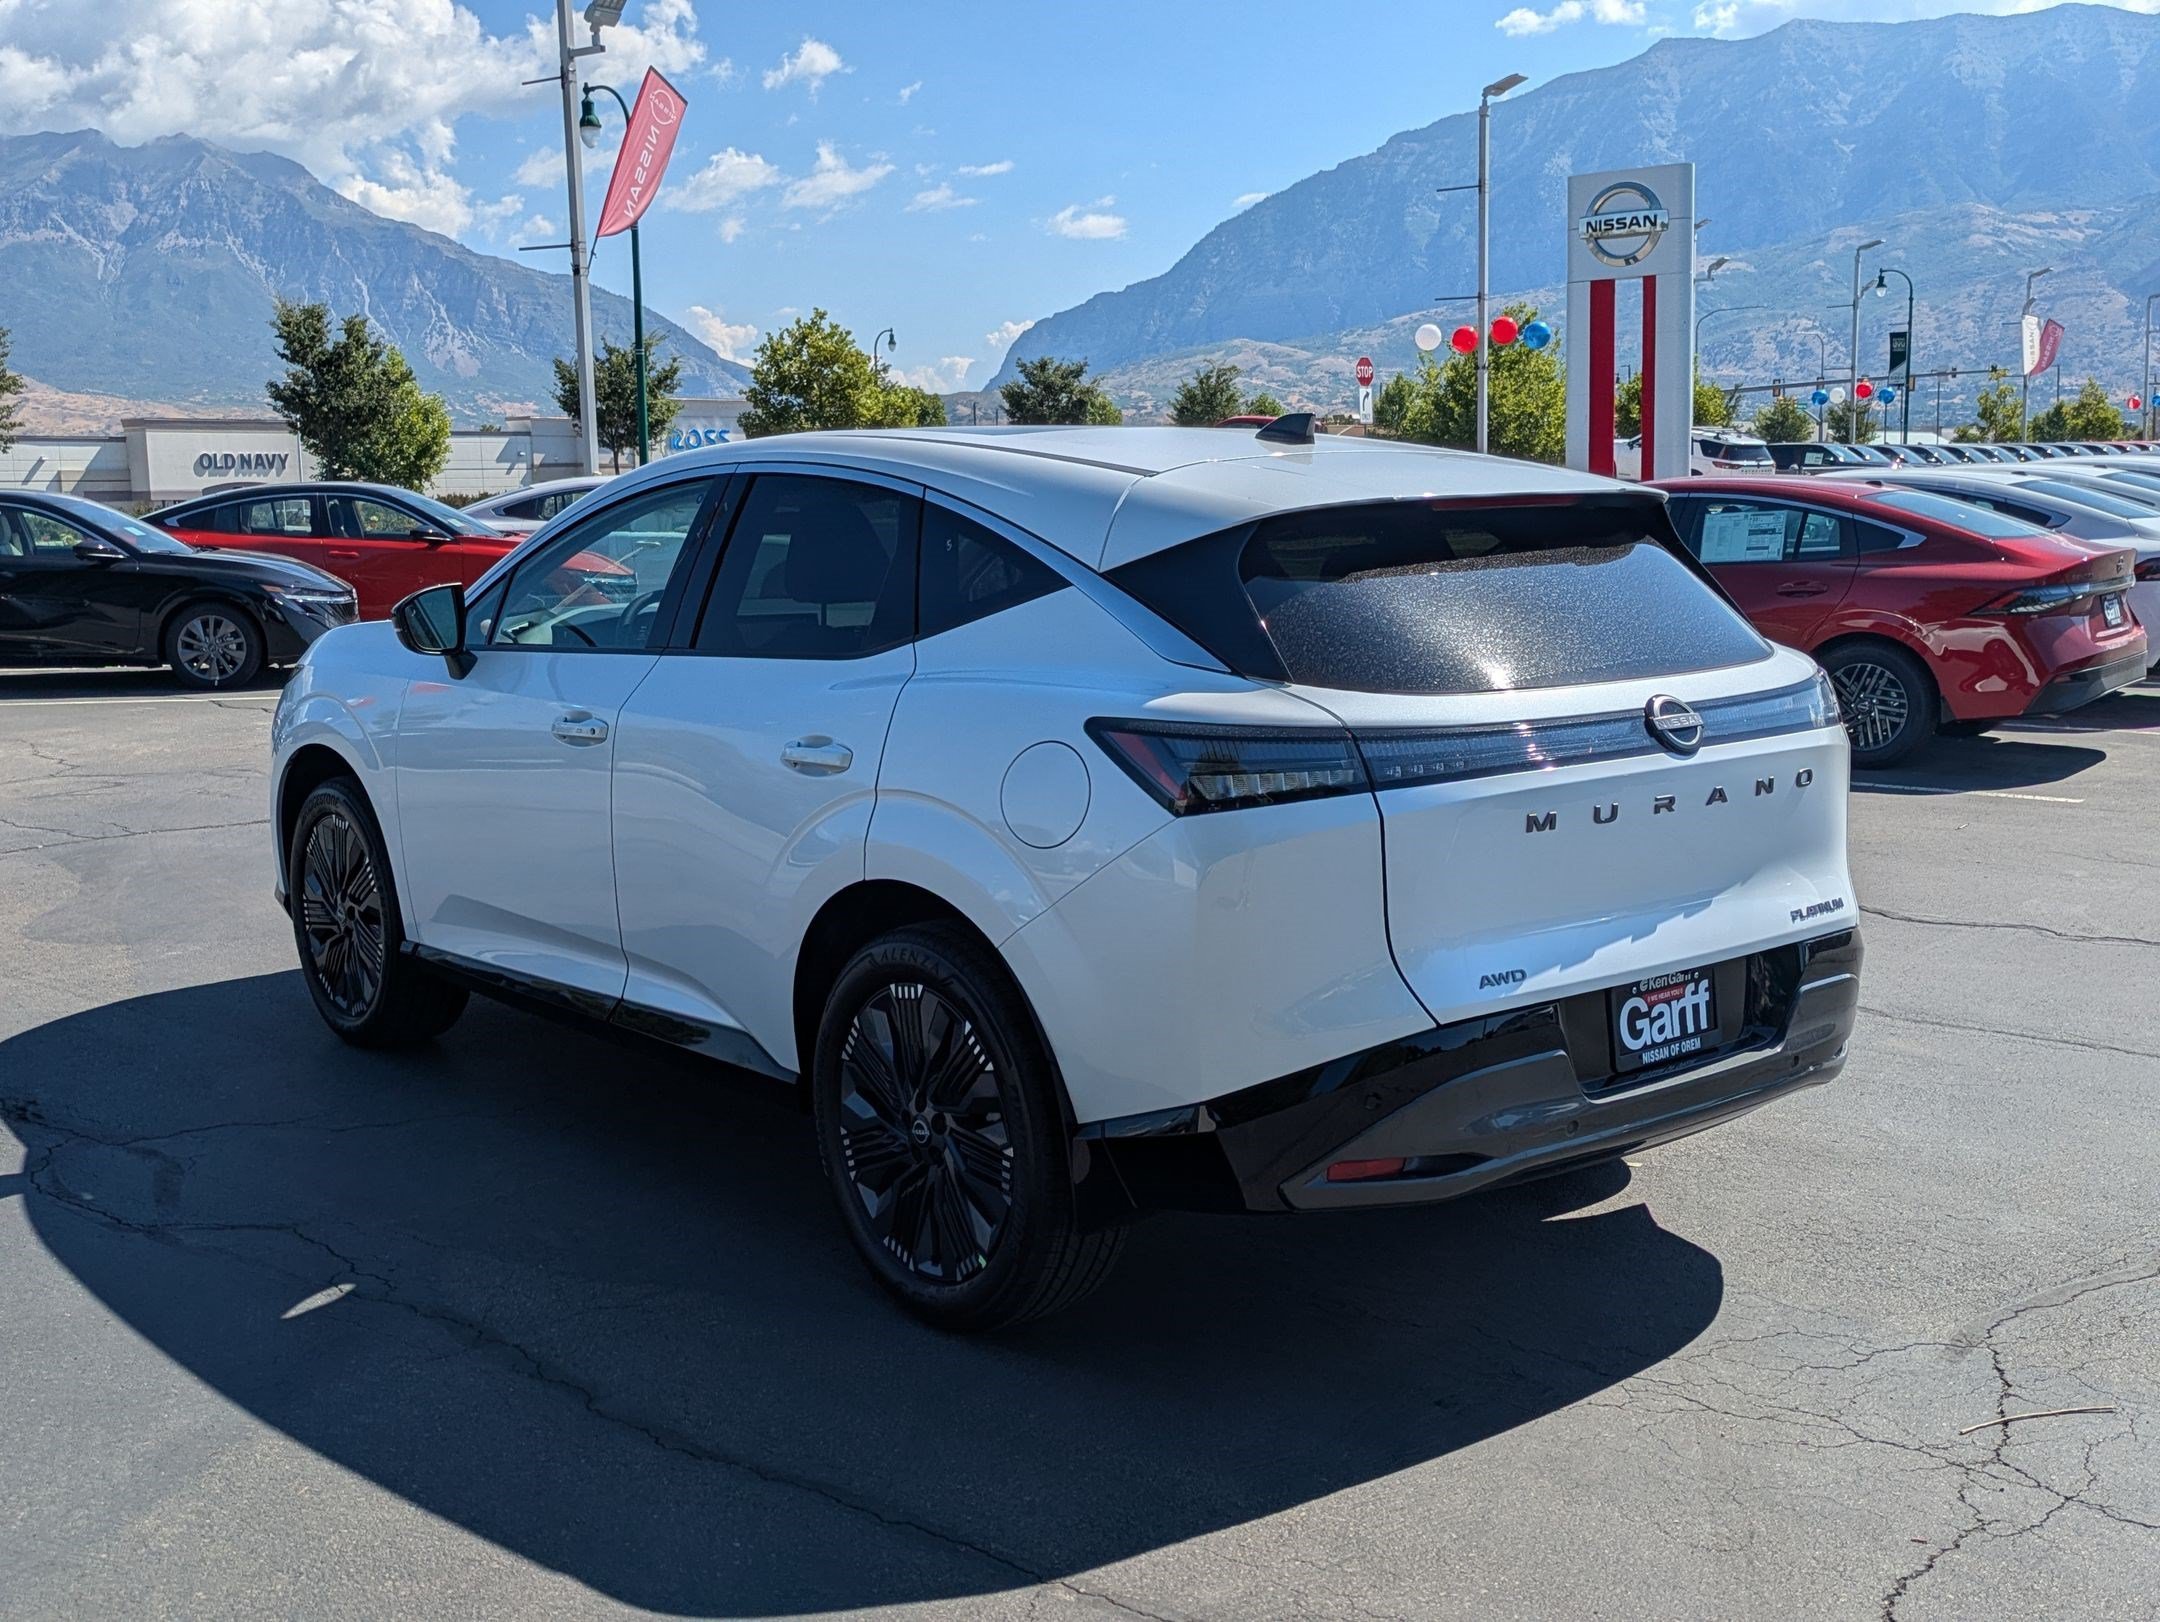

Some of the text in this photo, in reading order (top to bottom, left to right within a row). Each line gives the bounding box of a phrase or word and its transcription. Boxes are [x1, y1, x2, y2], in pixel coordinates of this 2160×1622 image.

[1586, 214, 1658, 234] NISSAN
[1357, 366, 1373, 378] STOP
[200, 453, 289, 470] OLD NAVY
[1657, 714, 1704, 730] NISSAN
[1525, 767, 1813, 834] MURANO
[1790, 897, 1845, 923] PLATINUM
[880, 947, 939, 977] ALENZA
[1479, 969, 1528, 990] AWD
[1649, 976, 1668, 990] Ken
[1619, 979, 1710, 1051] Garff
[1642, 1037, 1701, 1065] NISSAN OF OREM
